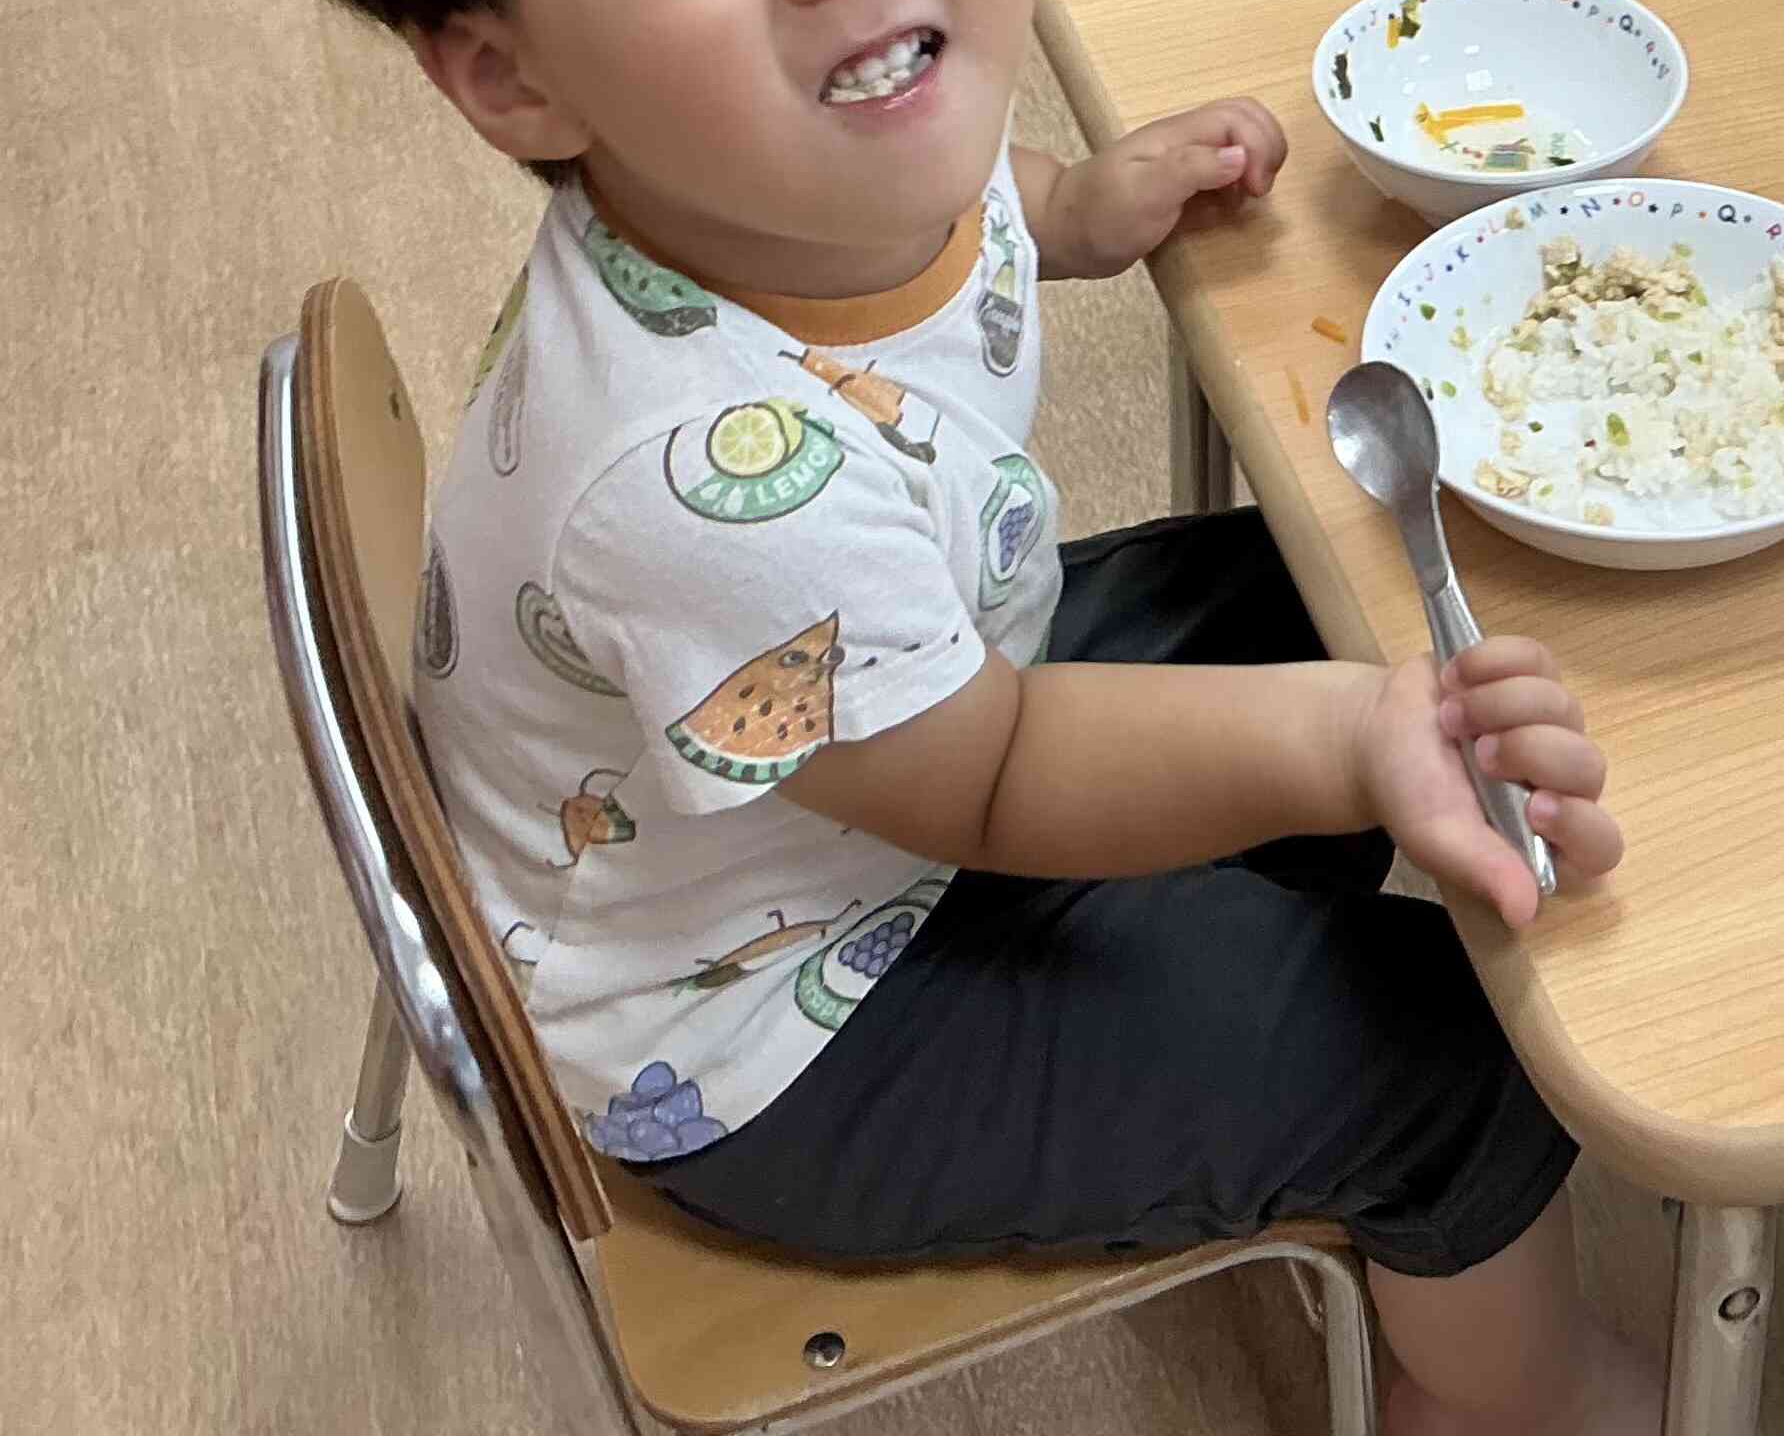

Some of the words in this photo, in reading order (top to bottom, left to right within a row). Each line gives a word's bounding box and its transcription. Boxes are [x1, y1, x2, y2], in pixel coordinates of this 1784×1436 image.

[1580, 197, 1602, 218] N
[1717, 204, 1737, 224] Q
[1765, 223, 1782, 240] R
